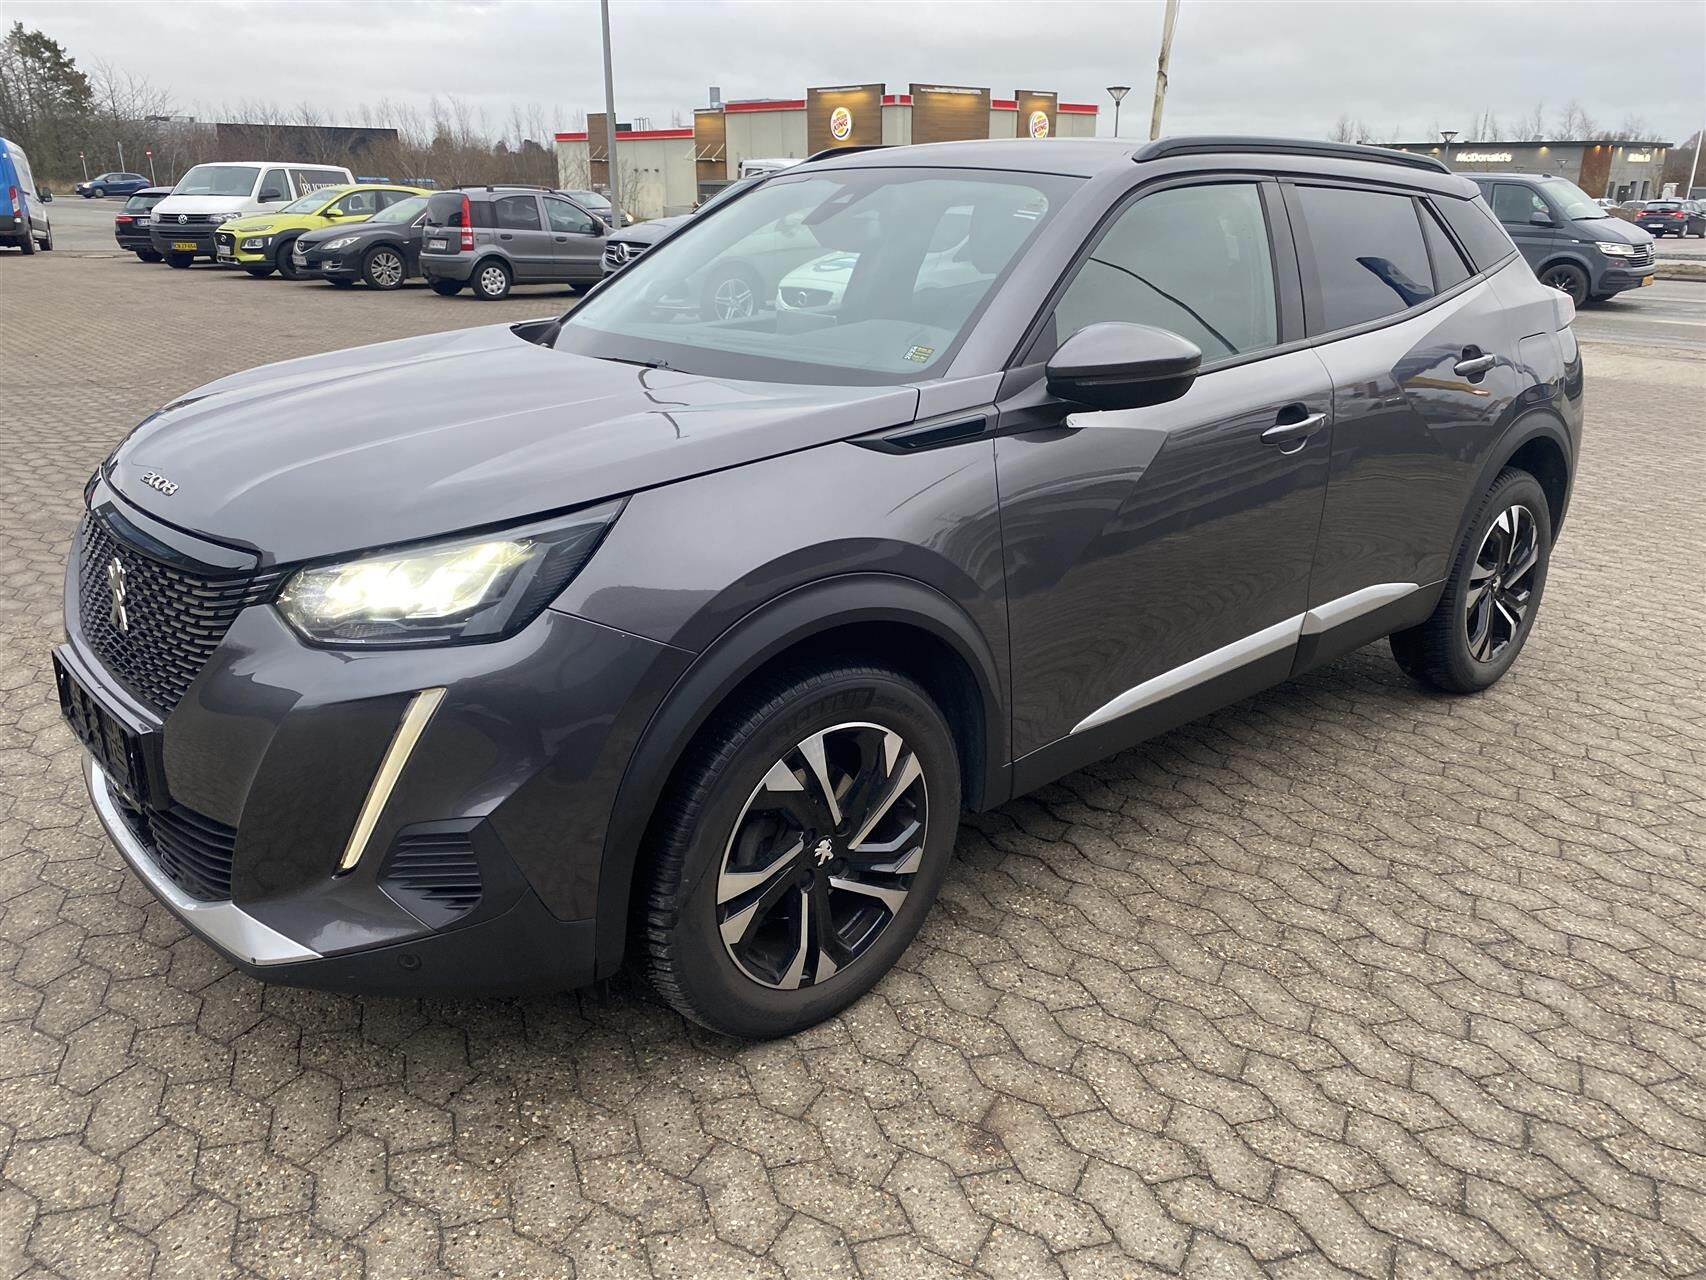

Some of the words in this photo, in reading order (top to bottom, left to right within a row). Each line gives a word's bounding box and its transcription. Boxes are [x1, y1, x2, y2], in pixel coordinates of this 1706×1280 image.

[833, 119, 848, 130] KING
[1456, 152, 1512, 162] McDonald's
[140, 470, 179, 496] 2008
